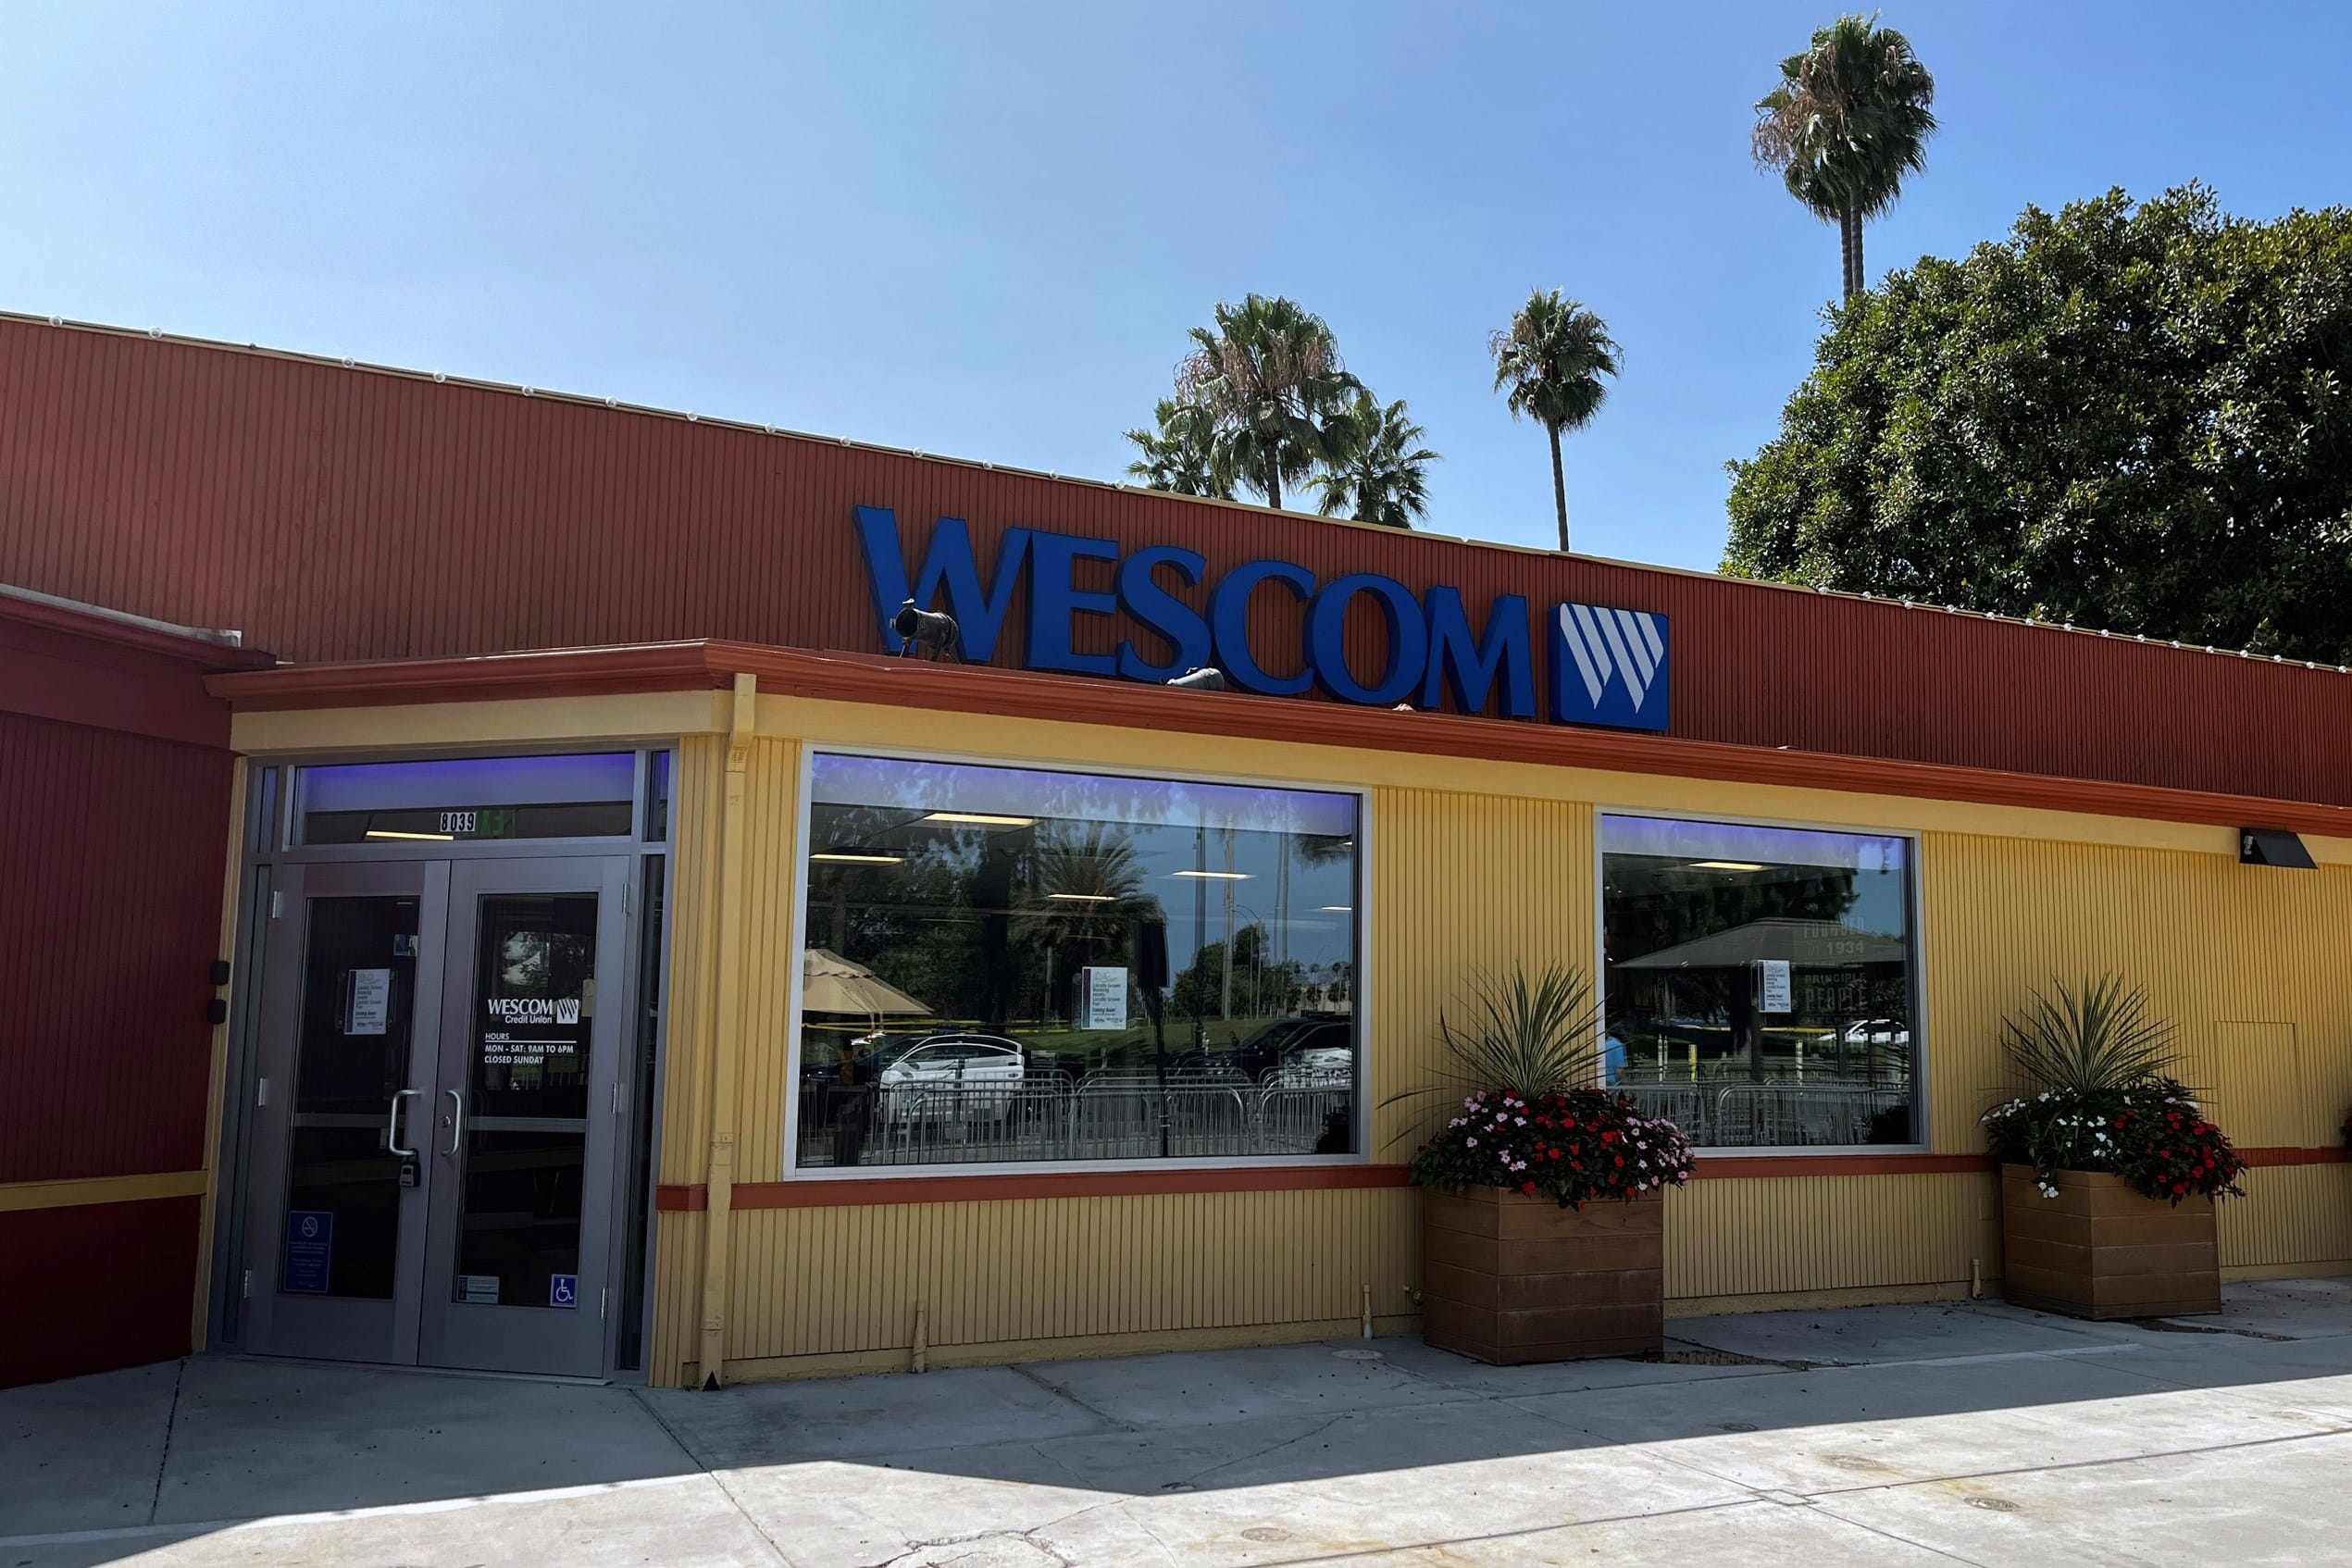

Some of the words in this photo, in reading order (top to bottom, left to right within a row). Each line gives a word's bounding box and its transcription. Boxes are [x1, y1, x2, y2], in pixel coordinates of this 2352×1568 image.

[852, 504, 1537, 717] WESCOM
[442, 813, 475, 831] 8039
[1826, 940, 1864, 956] 1934
[488, 999, 553, 1014] WESCOM
[504, 1015, 529, 1025] Credit
[529, 1015, 553, 1025] Union
[510, 1045, 526, 1053] SAT:
[528, 1045, 544, 1053] 9AM
[546, 1045, 556, 1053] TO
[557, 1045, 574, 1053] 6PM
[484, 1055, 512, 1064] CLOSED
[513, 1056, 544, 1064] SUNDAY
